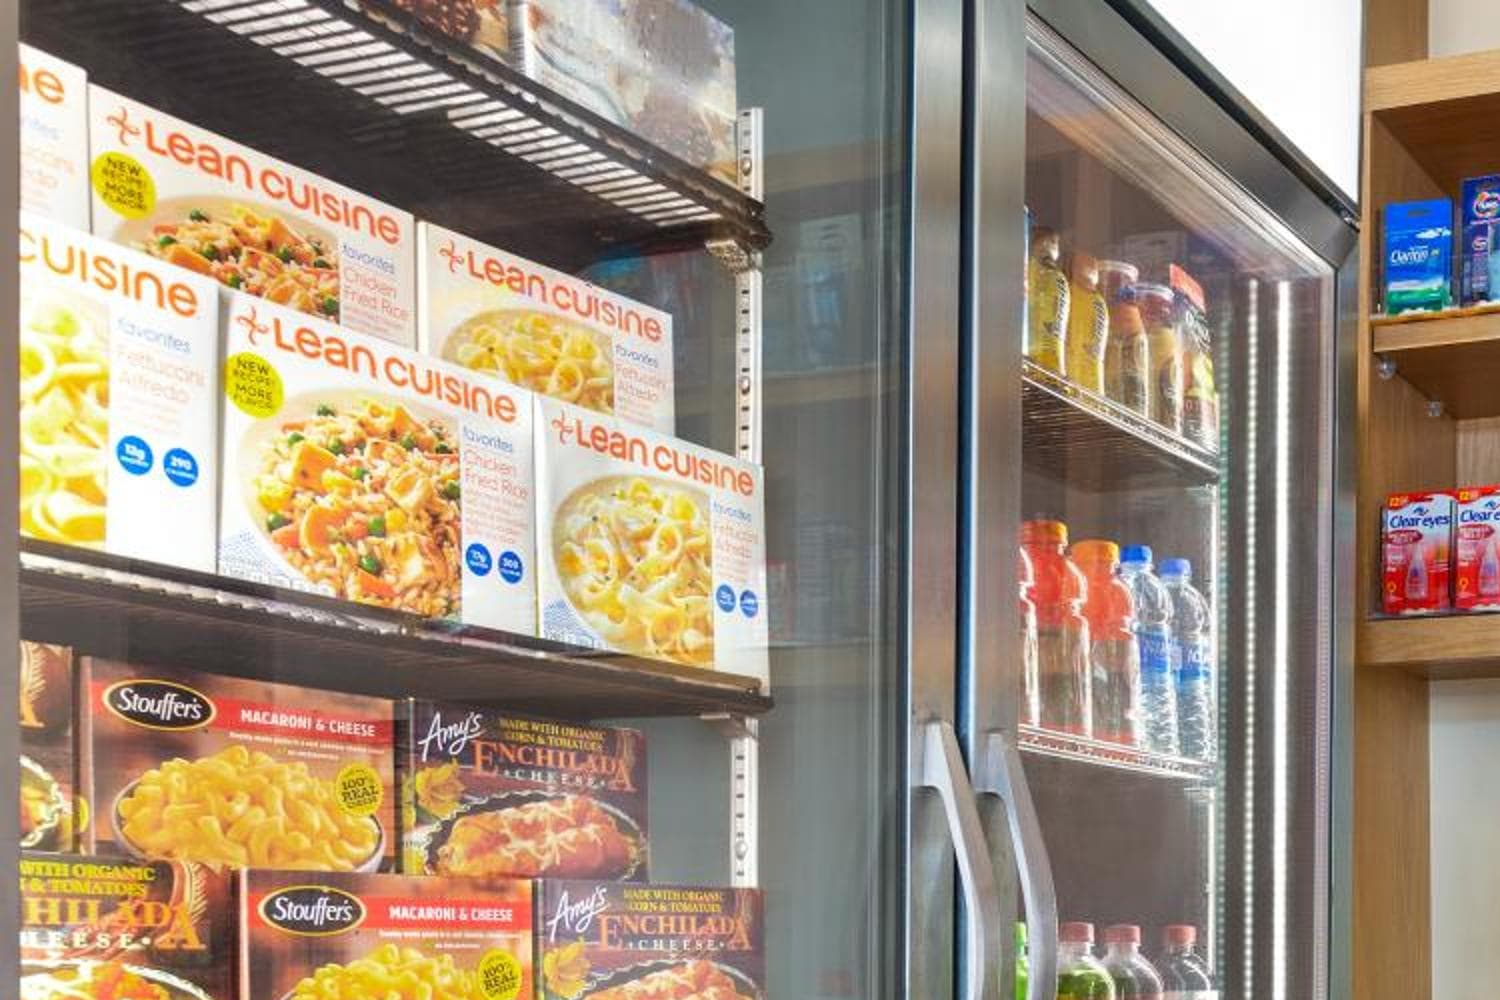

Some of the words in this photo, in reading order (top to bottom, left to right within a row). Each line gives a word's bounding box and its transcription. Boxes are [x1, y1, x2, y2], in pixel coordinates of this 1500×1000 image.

[145, 119, 253, 191] Lean
[105, 156, 140, 177] NEW
[105, 182, 145, 203] MORE
[467, 250, 548, 304] Lean
[273, 317, 379, 379] Lean
[236, 358, 270, 376] NEW
[235, 383, 274, 401] MORE
[576, 418, 650, 469] Lean
[1389, 515, 1421, 529] Clear
[1421, 514, 1450, 529] eyes
[1460, 509, 1492, 523] Clear
[117, 686, 203, 722] Stouffer's
[241, 708, 313, 731] MACARONI
[315, 719, 326, 733] &
[328, 720, 377, 738] CHEESE
[417, 711, 487, 763] Amy's
[471, 739, 639, 793] ENCHILADA
[341, 785, 380, 804] REAL
[71, 863, 157, 882] ORGANIC
[49, 878, 147, 897] TOMATOES
[273, 895, 354, 927] Stouffer's
[388, 905, 456, 921] MACARONI
[457, 906, 468, 921] &
[470, 907, 514, 922] CHEESE
[546, 886, 612, 943] Amy's
[596, 911, 752, 951] ENCHILADA
[638, 938, 718, 952] CHEESE
[483, 972, 517, 991] REAL
